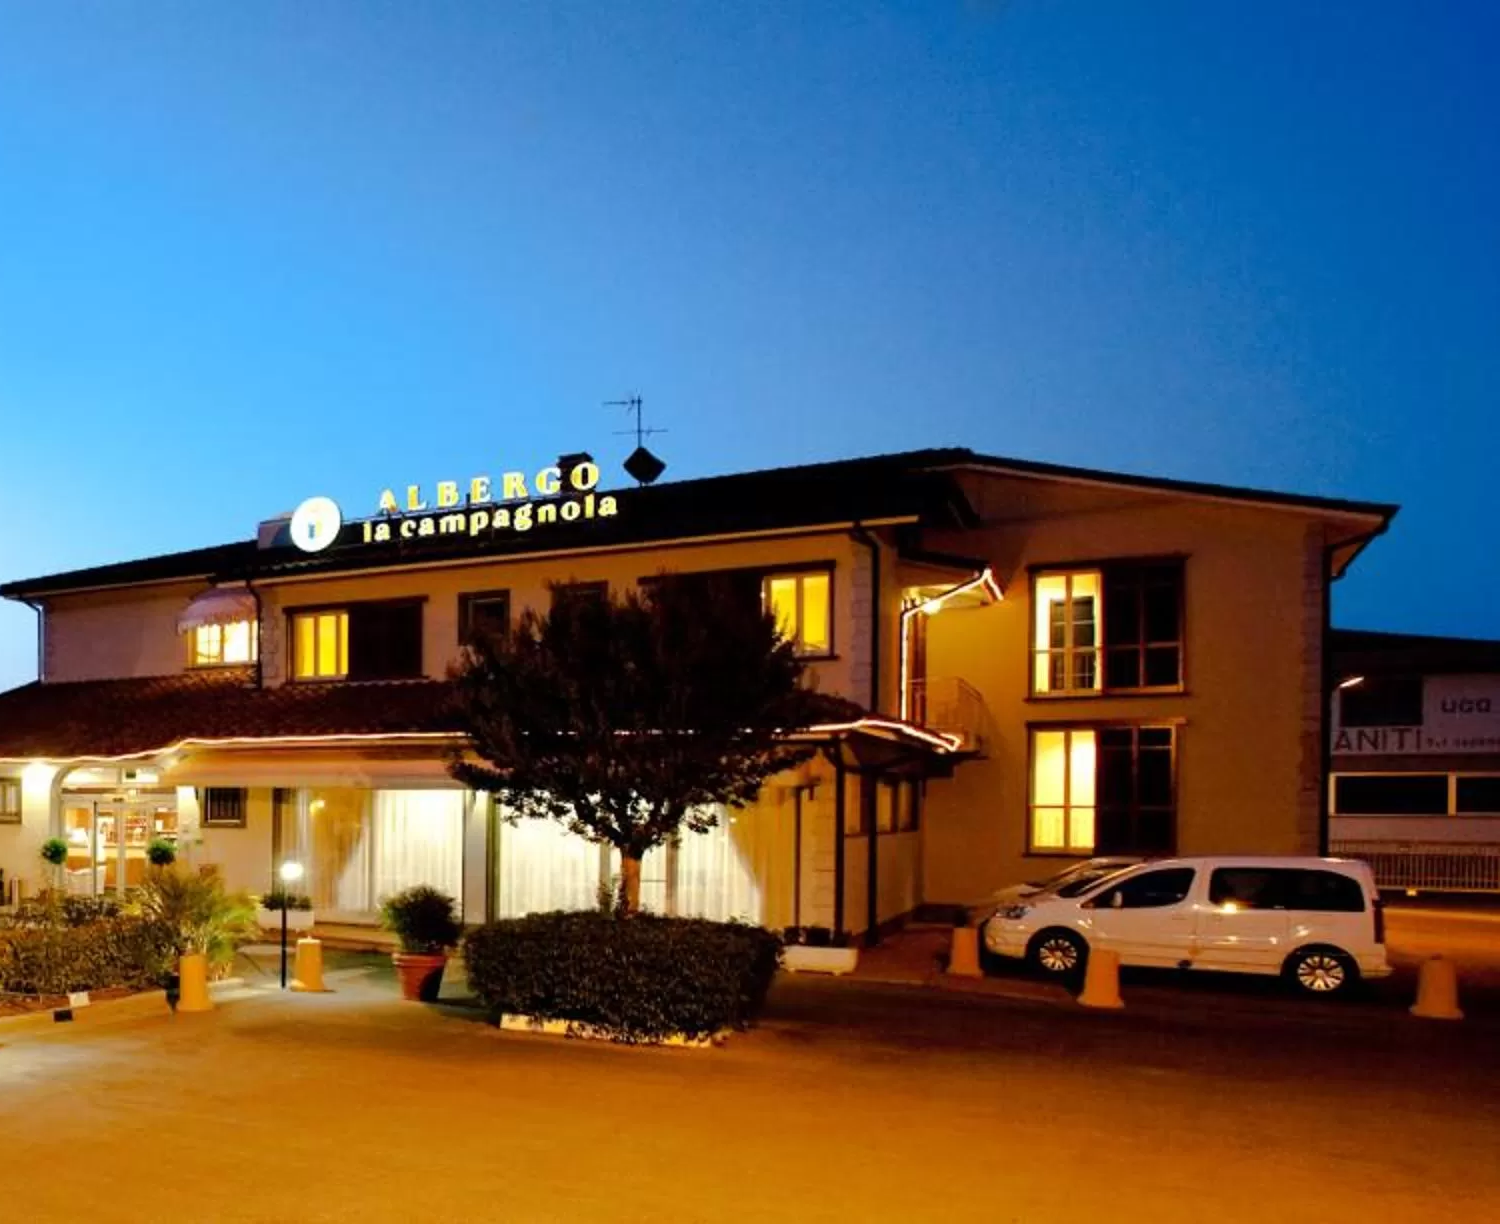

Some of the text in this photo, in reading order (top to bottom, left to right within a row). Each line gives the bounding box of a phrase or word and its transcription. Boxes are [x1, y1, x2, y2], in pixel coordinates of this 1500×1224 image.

[379, 461, 600, 513] ALBERGO
[362, 492, 619, 544] la campagnola
